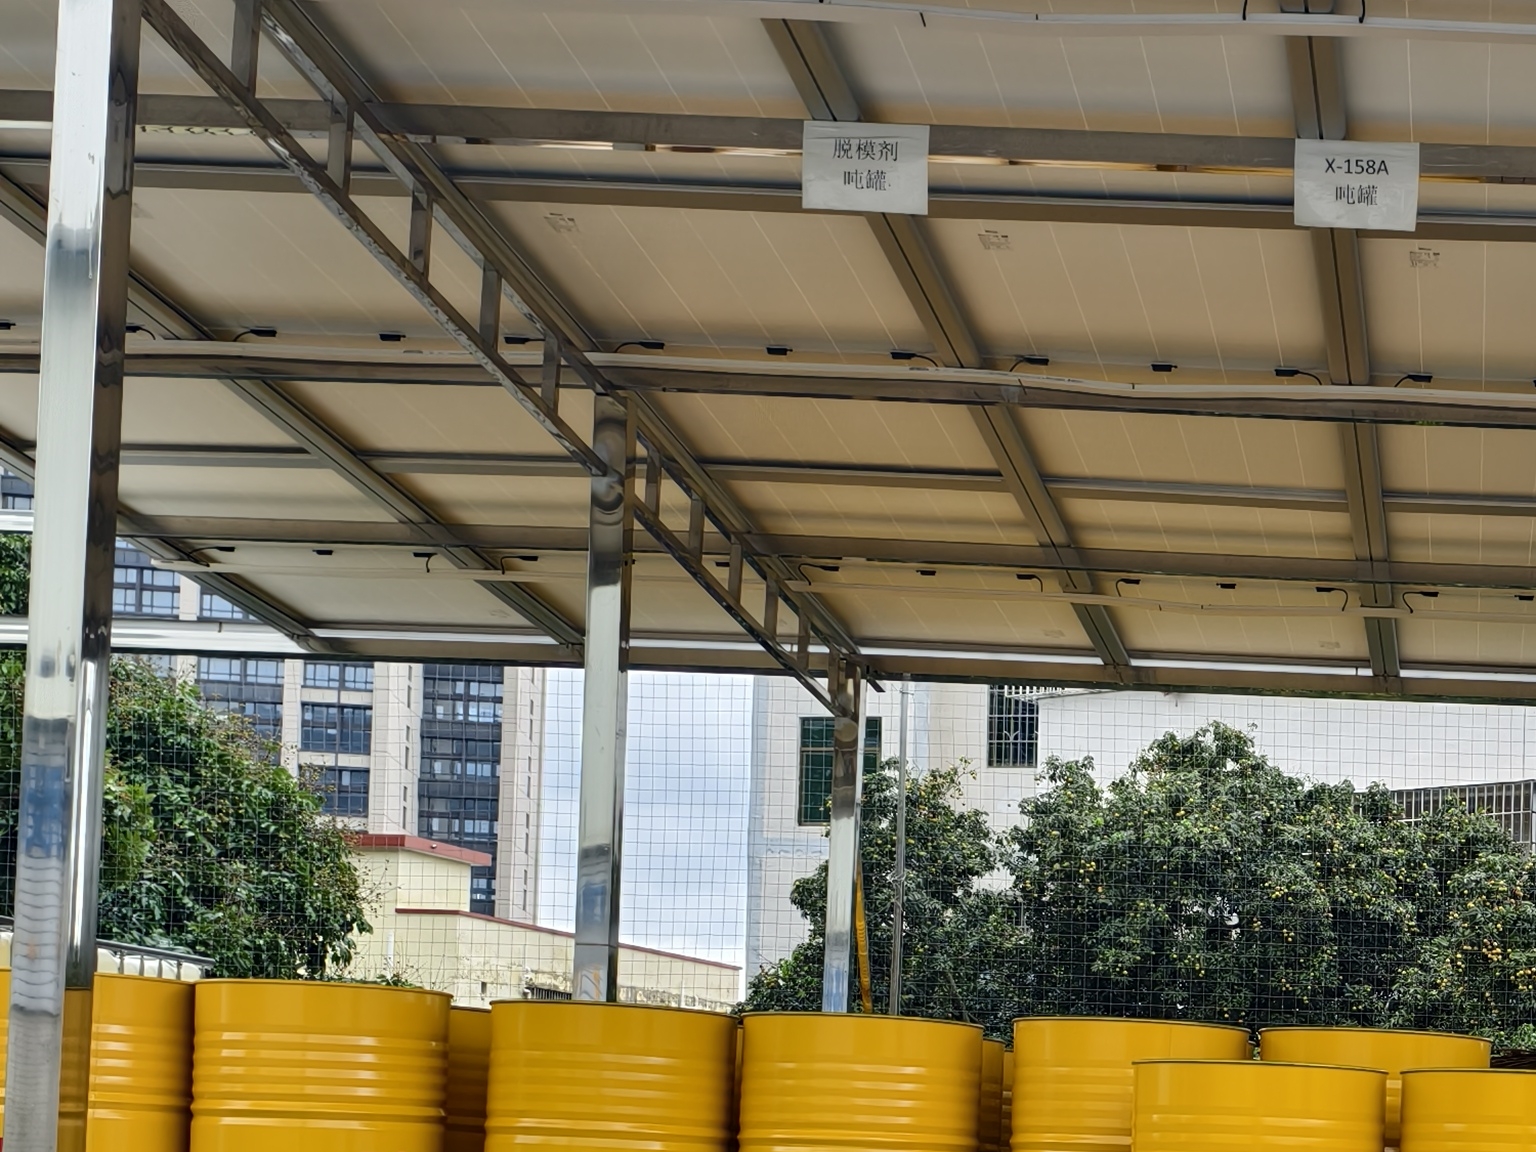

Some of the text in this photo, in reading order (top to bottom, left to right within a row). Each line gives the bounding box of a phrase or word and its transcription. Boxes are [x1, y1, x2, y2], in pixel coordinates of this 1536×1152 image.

[832, 138, 899, 161] 脱模剂
[1324, 157, 1390, 176] X-158A
[843, 169, 887, 191] 吨罐
[1335, 184, 1379, 206] 吨罐
